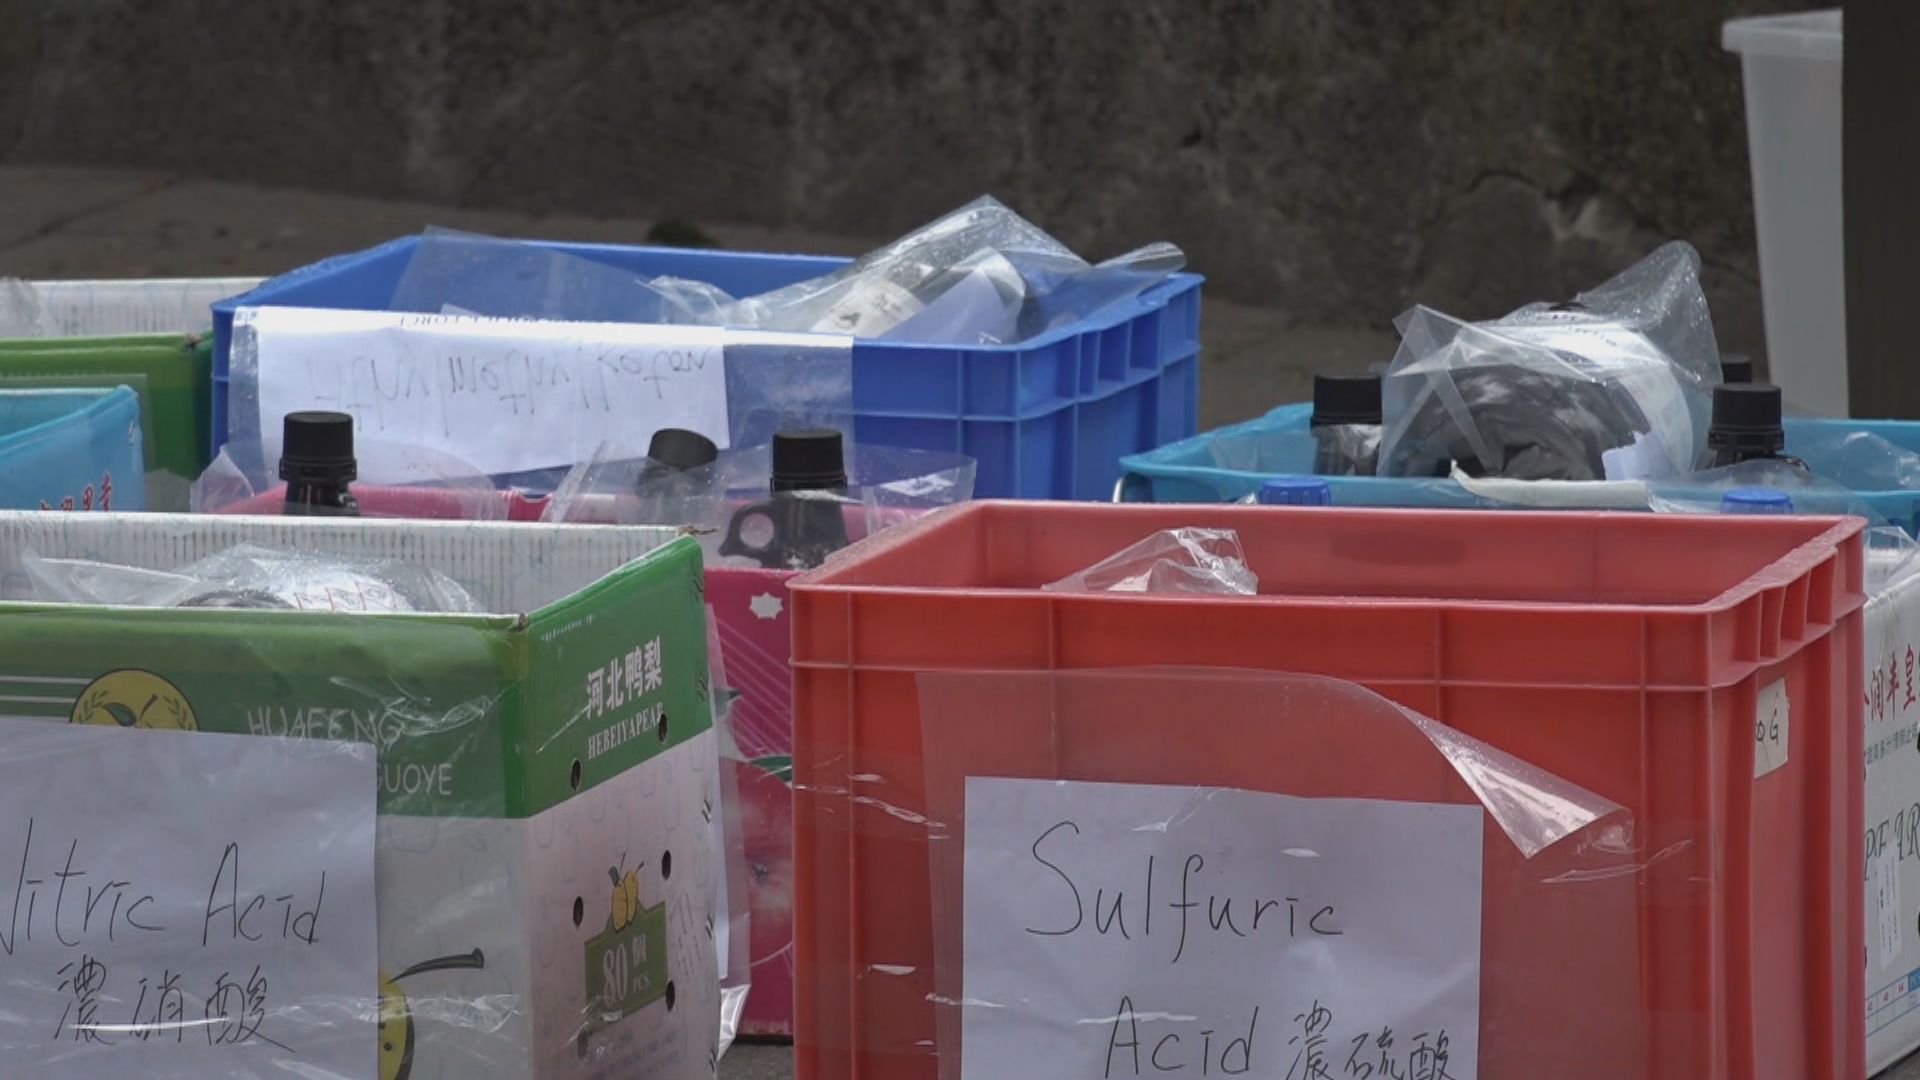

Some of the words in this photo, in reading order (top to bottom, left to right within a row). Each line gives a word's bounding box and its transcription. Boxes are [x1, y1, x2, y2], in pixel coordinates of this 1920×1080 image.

[586, 635, 663, 720] 河北鸭梨
[377, 763, 453, 795] UOYE
[202, 841, 326, 946] Acid
[1025, 820, 1344, 963] Sulfuric
[601, 943, 629, 1008] 80
[1105, 996, 1259, 1079] Acid
